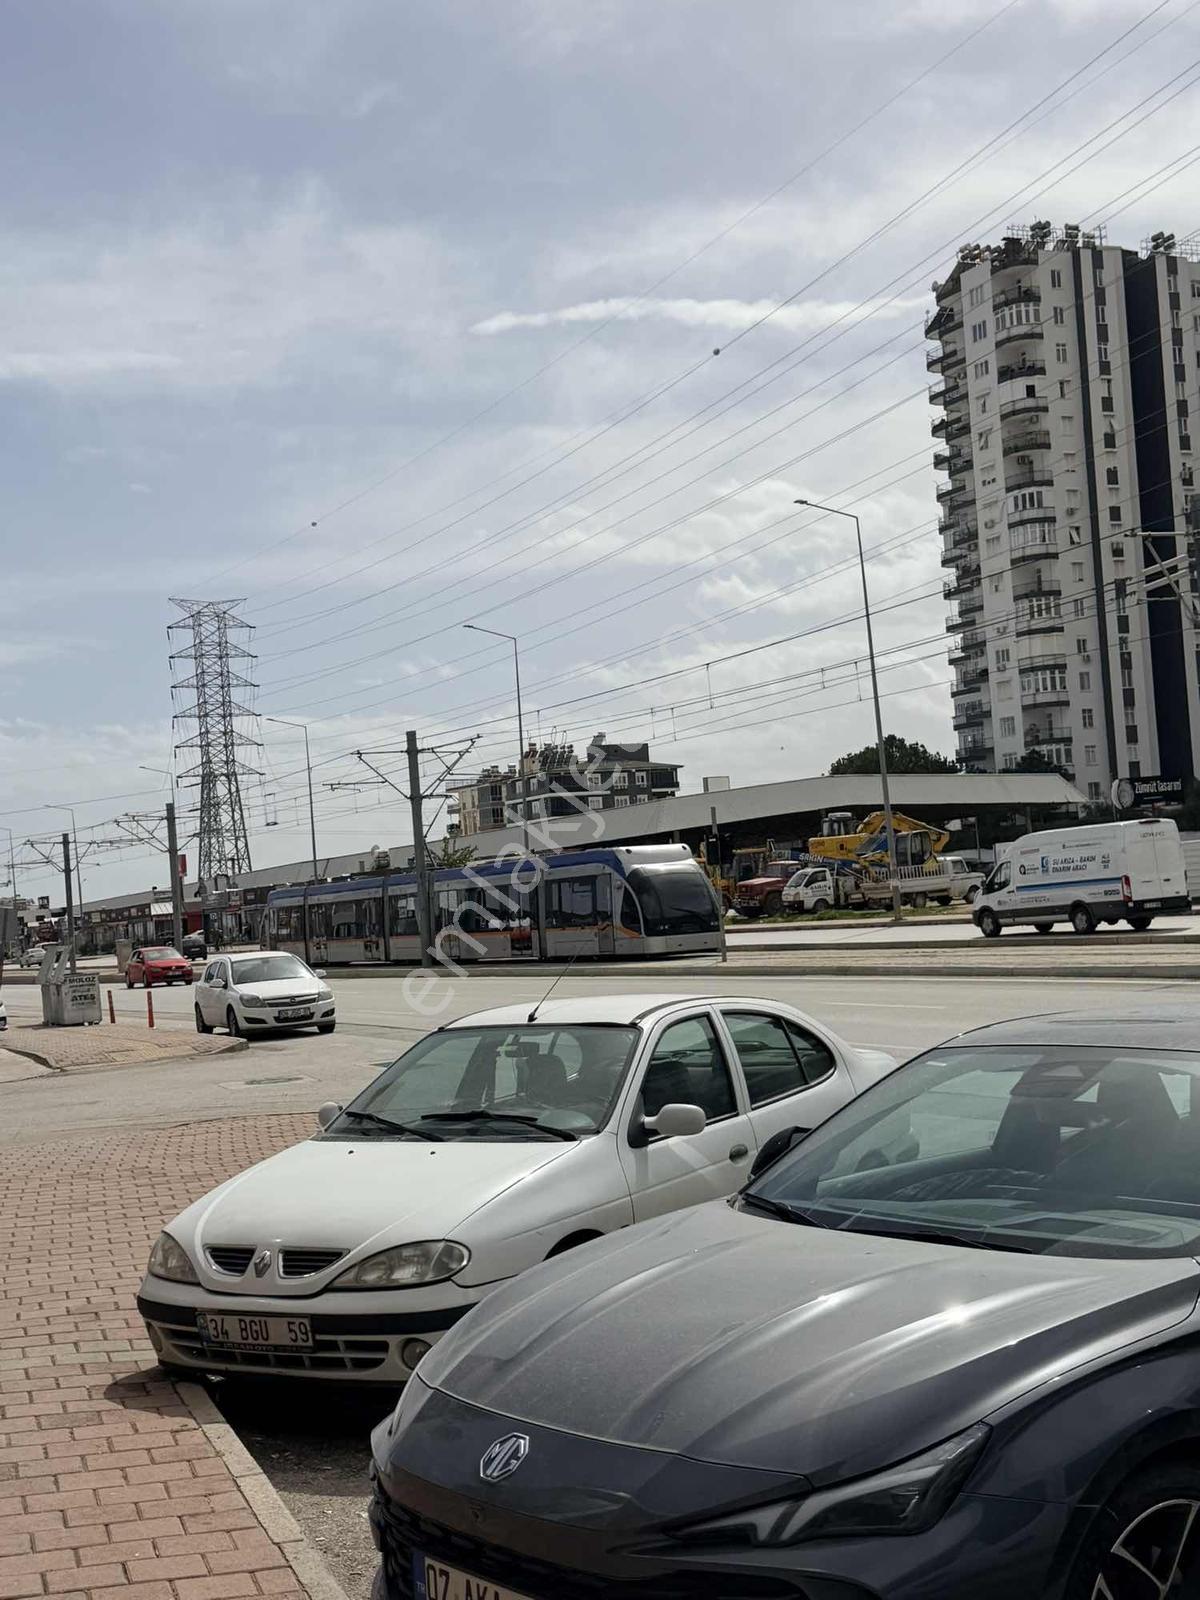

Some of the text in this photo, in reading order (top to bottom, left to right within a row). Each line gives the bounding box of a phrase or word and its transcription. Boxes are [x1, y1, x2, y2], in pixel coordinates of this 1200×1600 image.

[209, 1318, 310, 1343] 34 BGU 59
